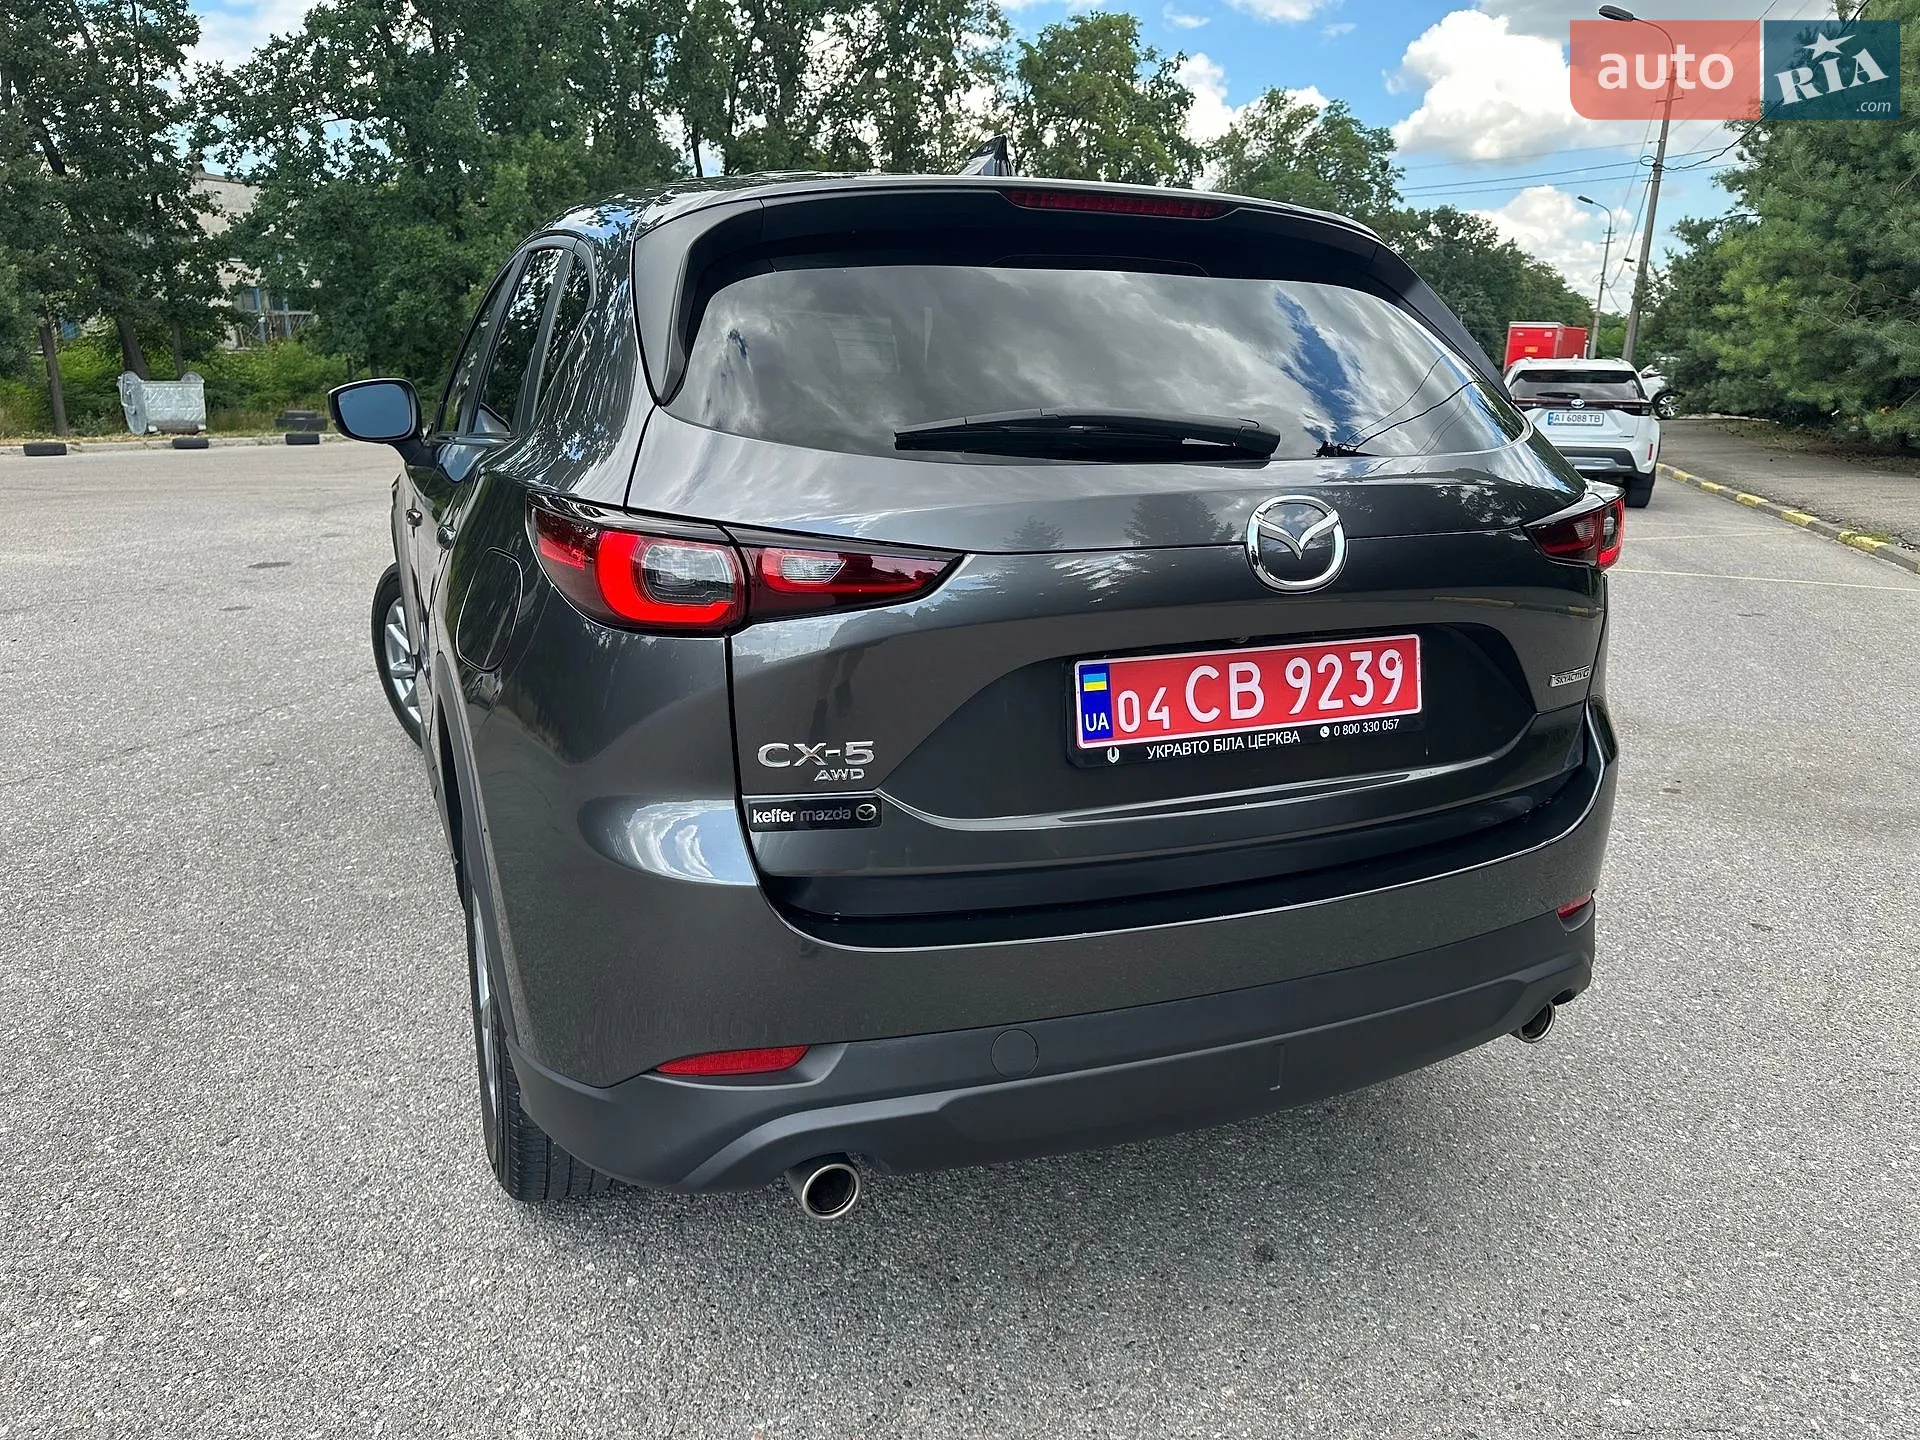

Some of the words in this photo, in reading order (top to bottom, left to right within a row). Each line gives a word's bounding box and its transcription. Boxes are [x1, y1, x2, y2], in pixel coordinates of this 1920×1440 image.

[1117, 687, 1171, 733] 04
[1185, 661, 1266, 723] CB
[1285, 648, 1405, 715] 9239
[1085, 712, 1110, 732] UA
[1333, 725, 1340, 736] 0
[1342, 723, 1360, 735] 800
[1362, 721, 1380, 733] 330
[1382, 719, 1400, 731] 057
[757, 740, 875, 768] CX-5
[1147, 740, 1210, 759] УКРАВТО
[1213, 737, 1245, 752] БІЛА
[1248, 730, 1301, 749] ЦЕРКВА
[814, 768, 865, 782] AWD
[752, 808, 797, 824] keffer
[799, 807, 851, 822] mazda
